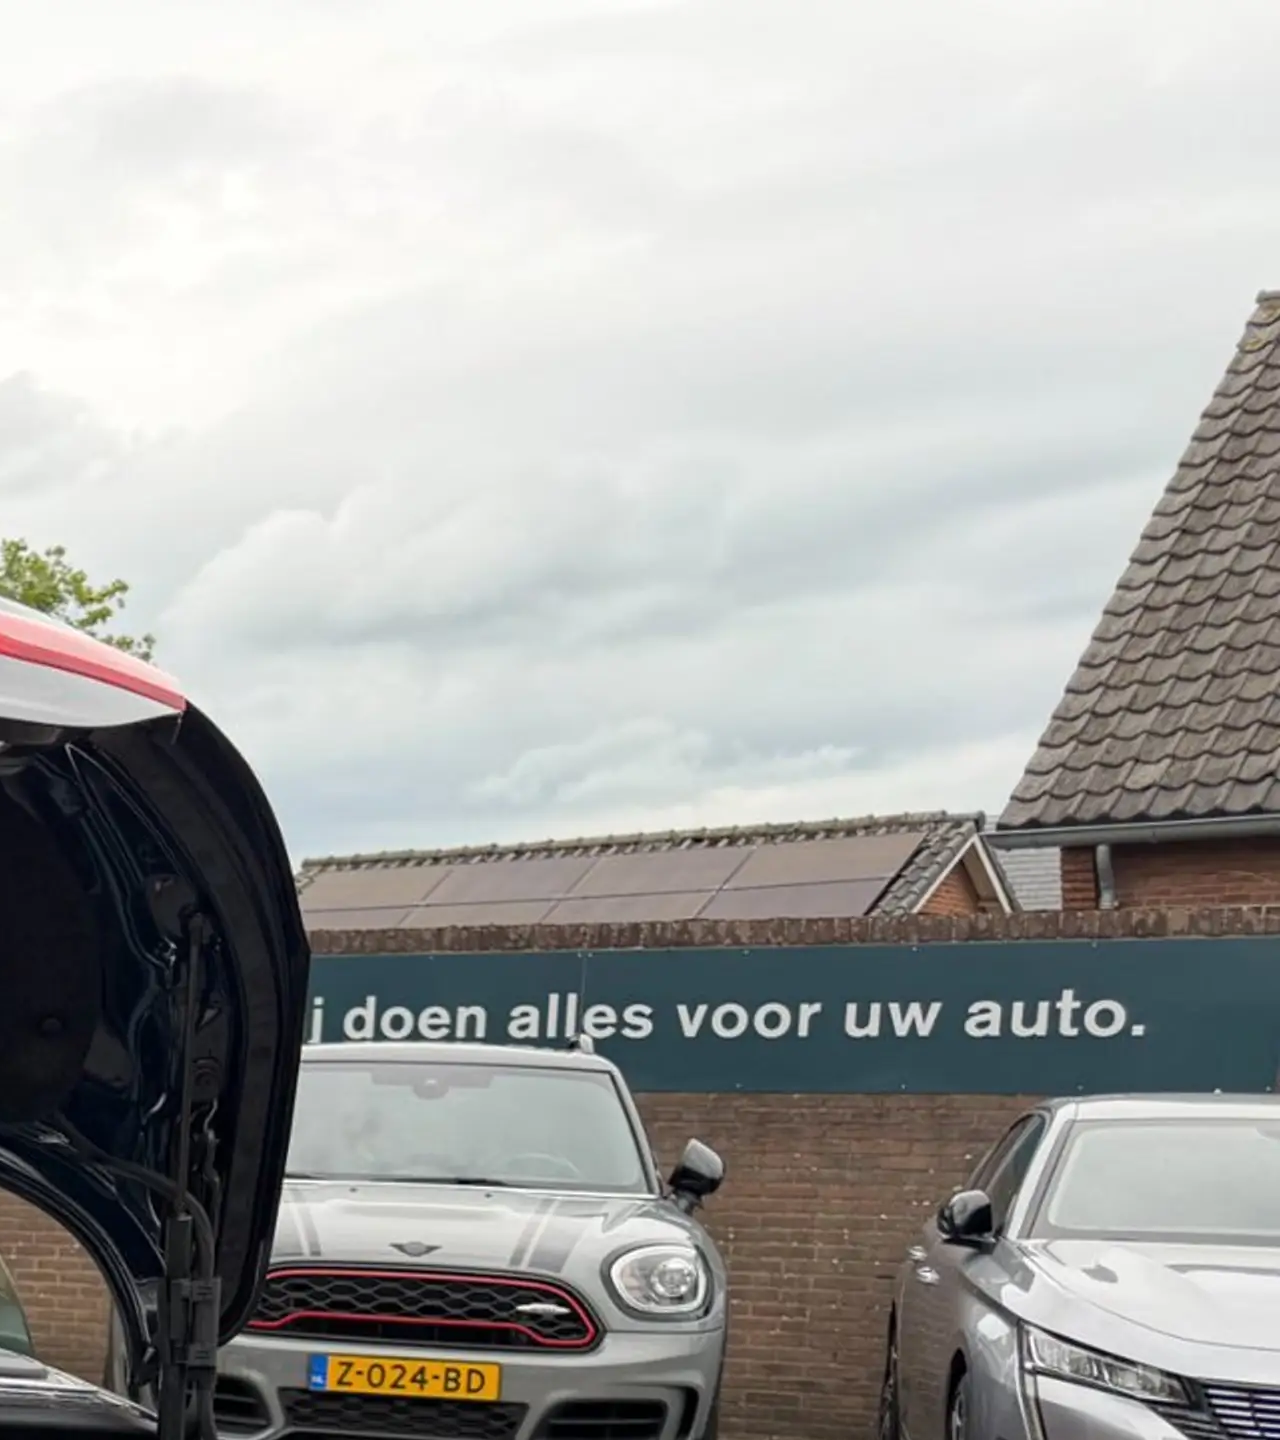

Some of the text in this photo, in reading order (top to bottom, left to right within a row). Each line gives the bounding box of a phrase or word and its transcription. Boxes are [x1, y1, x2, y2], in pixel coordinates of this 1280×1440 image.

[343, 995, 486, 1039] doen
[507, 993, 653, 1039] alles
[677, 1002, 821, 1037] voor
[844, 1001, 942, 1037] uw
[964, 990, 1146, 1037] auto.
[337, 1361, 486, 1393] Z-024-BD
